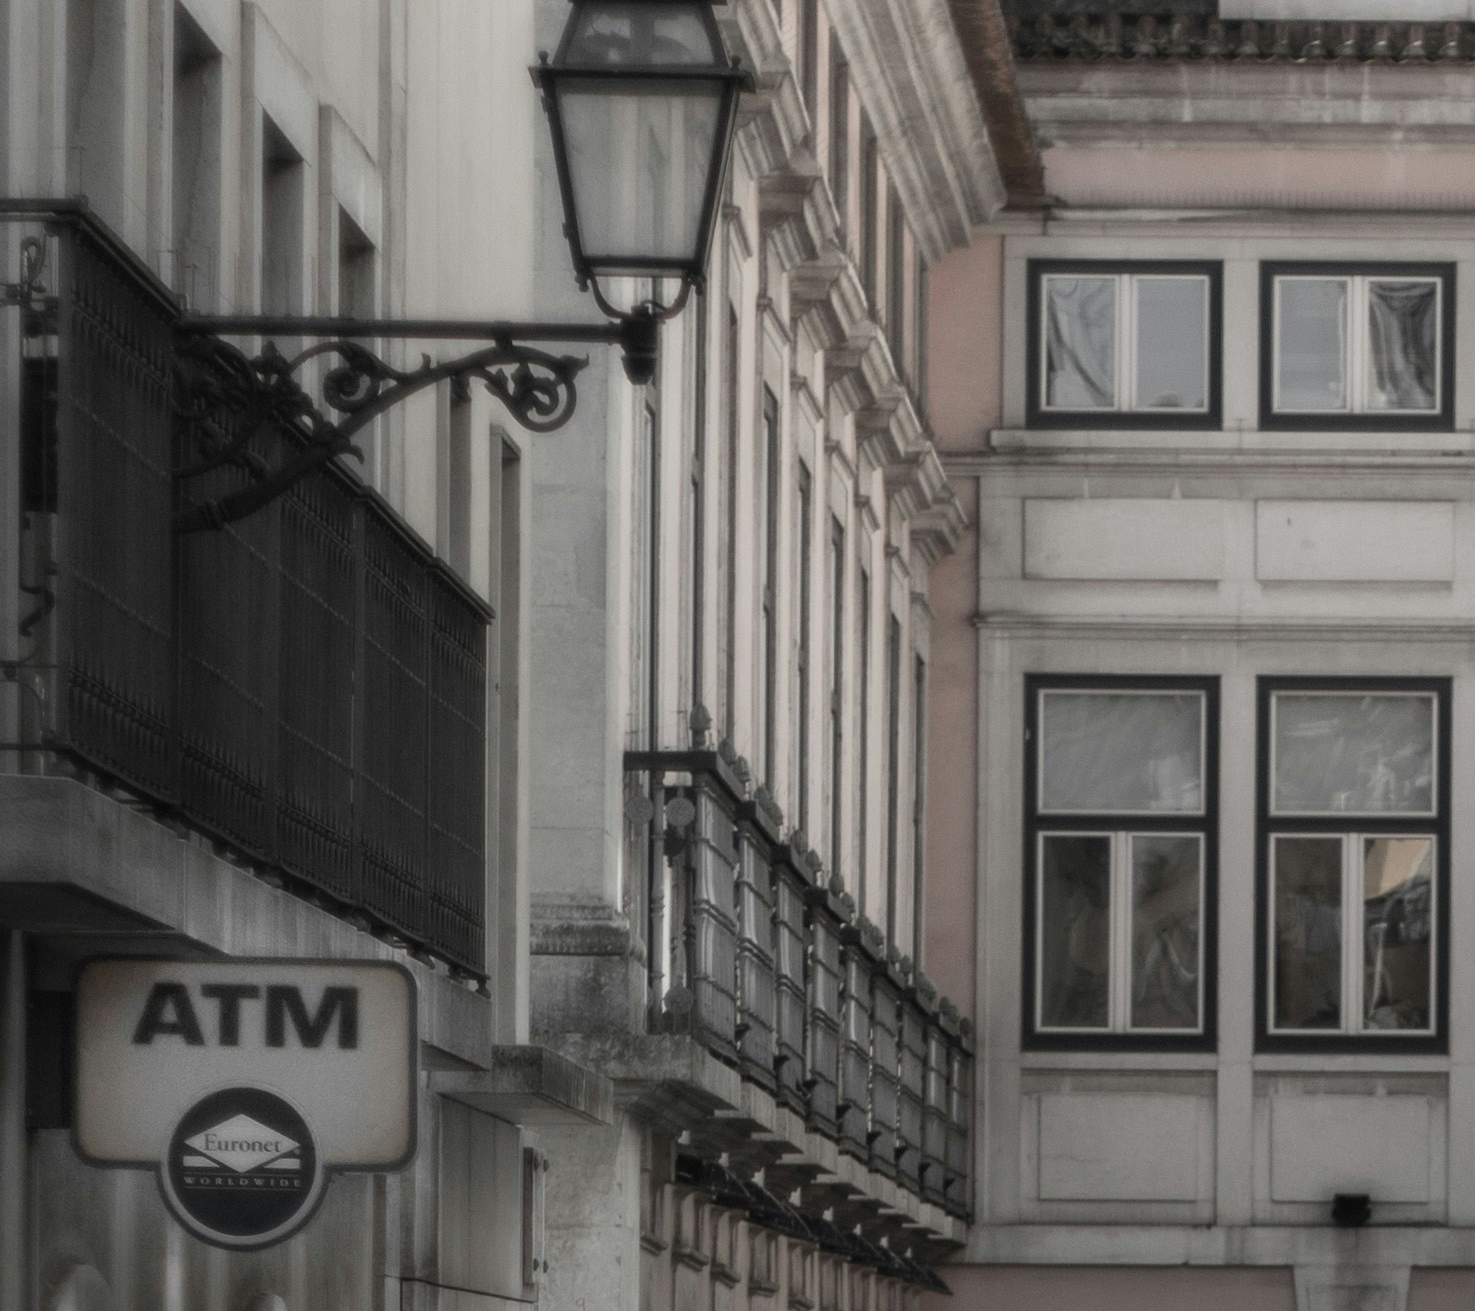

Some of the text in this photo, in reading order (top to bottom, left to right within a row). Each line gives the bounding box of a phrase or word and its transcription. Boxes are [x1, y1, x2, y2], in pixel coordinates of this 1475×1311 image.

[132, 982, 359, 1049] ATM
[203, 1132, 282, 1154] Euronet
[183, 1175, 301, 1188] WORLDWIDE
